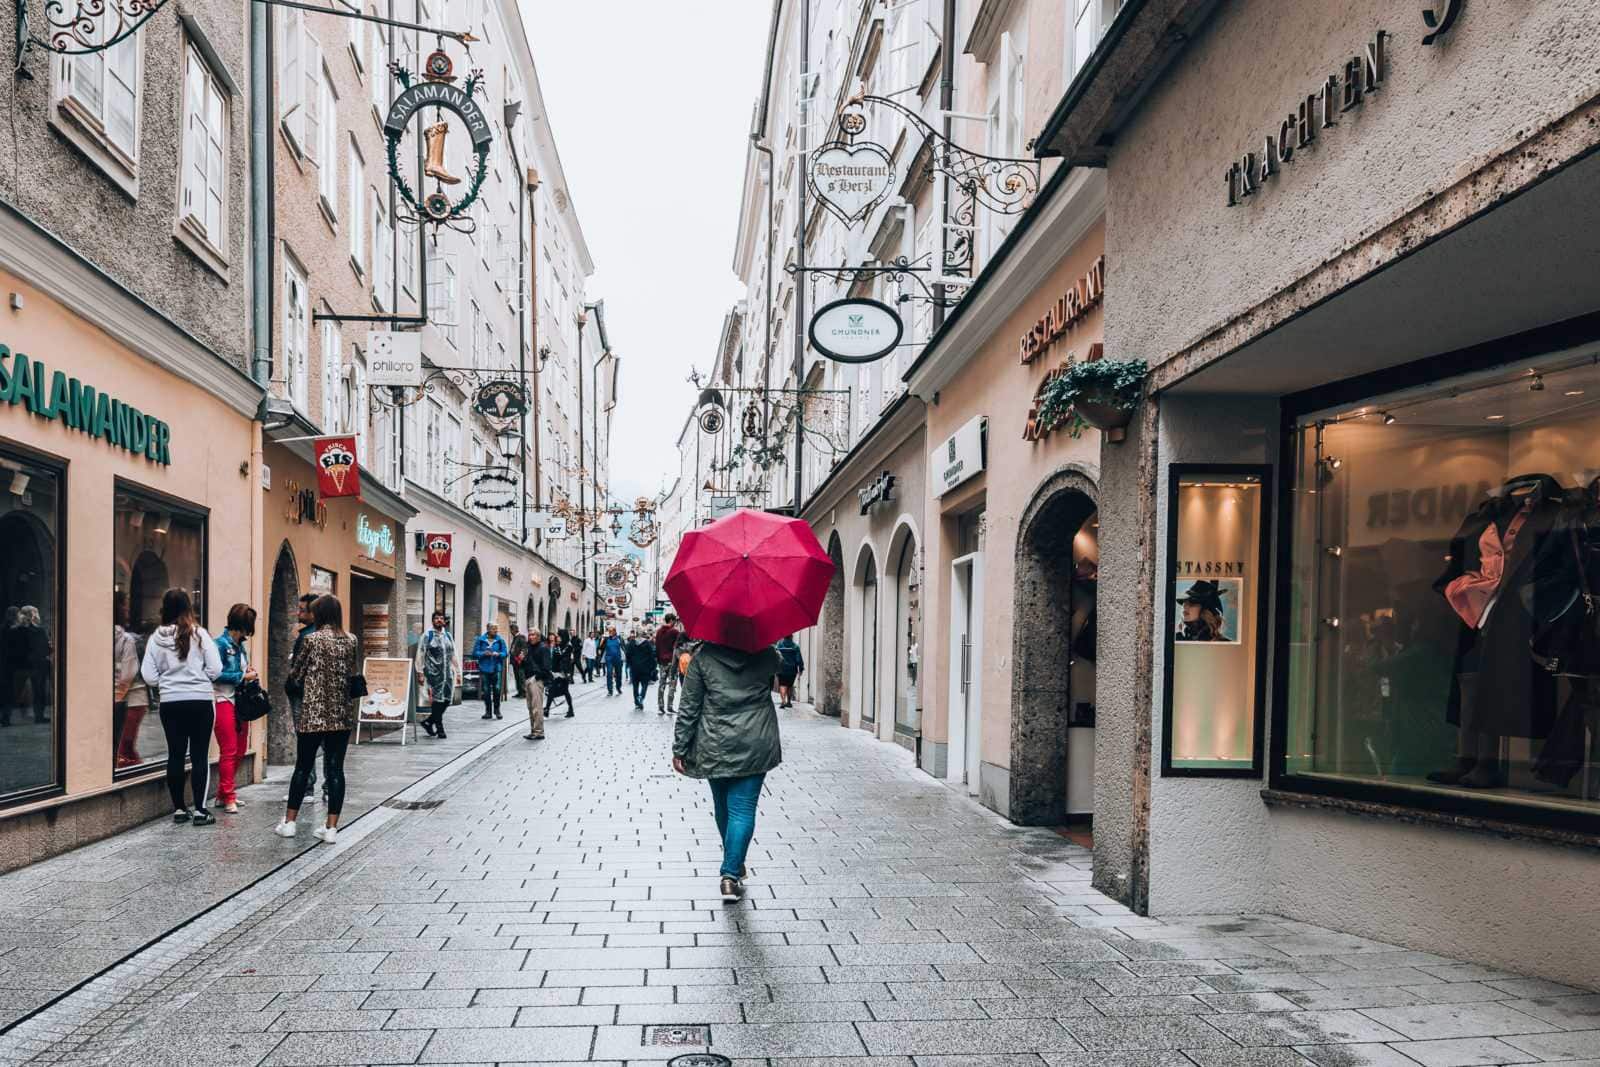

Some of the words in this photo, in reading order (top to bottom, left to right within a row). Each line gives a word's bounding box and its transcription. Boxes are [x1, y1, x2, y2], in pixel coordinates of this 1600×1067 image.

[391, 85, 485, 132] SALAMANDER
[1225, 30, 1391, 206] TRACHTEN
[815, 162, 887, 177] Restaurant
[831, 328, 881, 336] GMUNDNER
[373, 360, 414, 372] philoro
[0, 343, 171, 466] SALAMANDER
[321, 453, 353, 468] EIS
